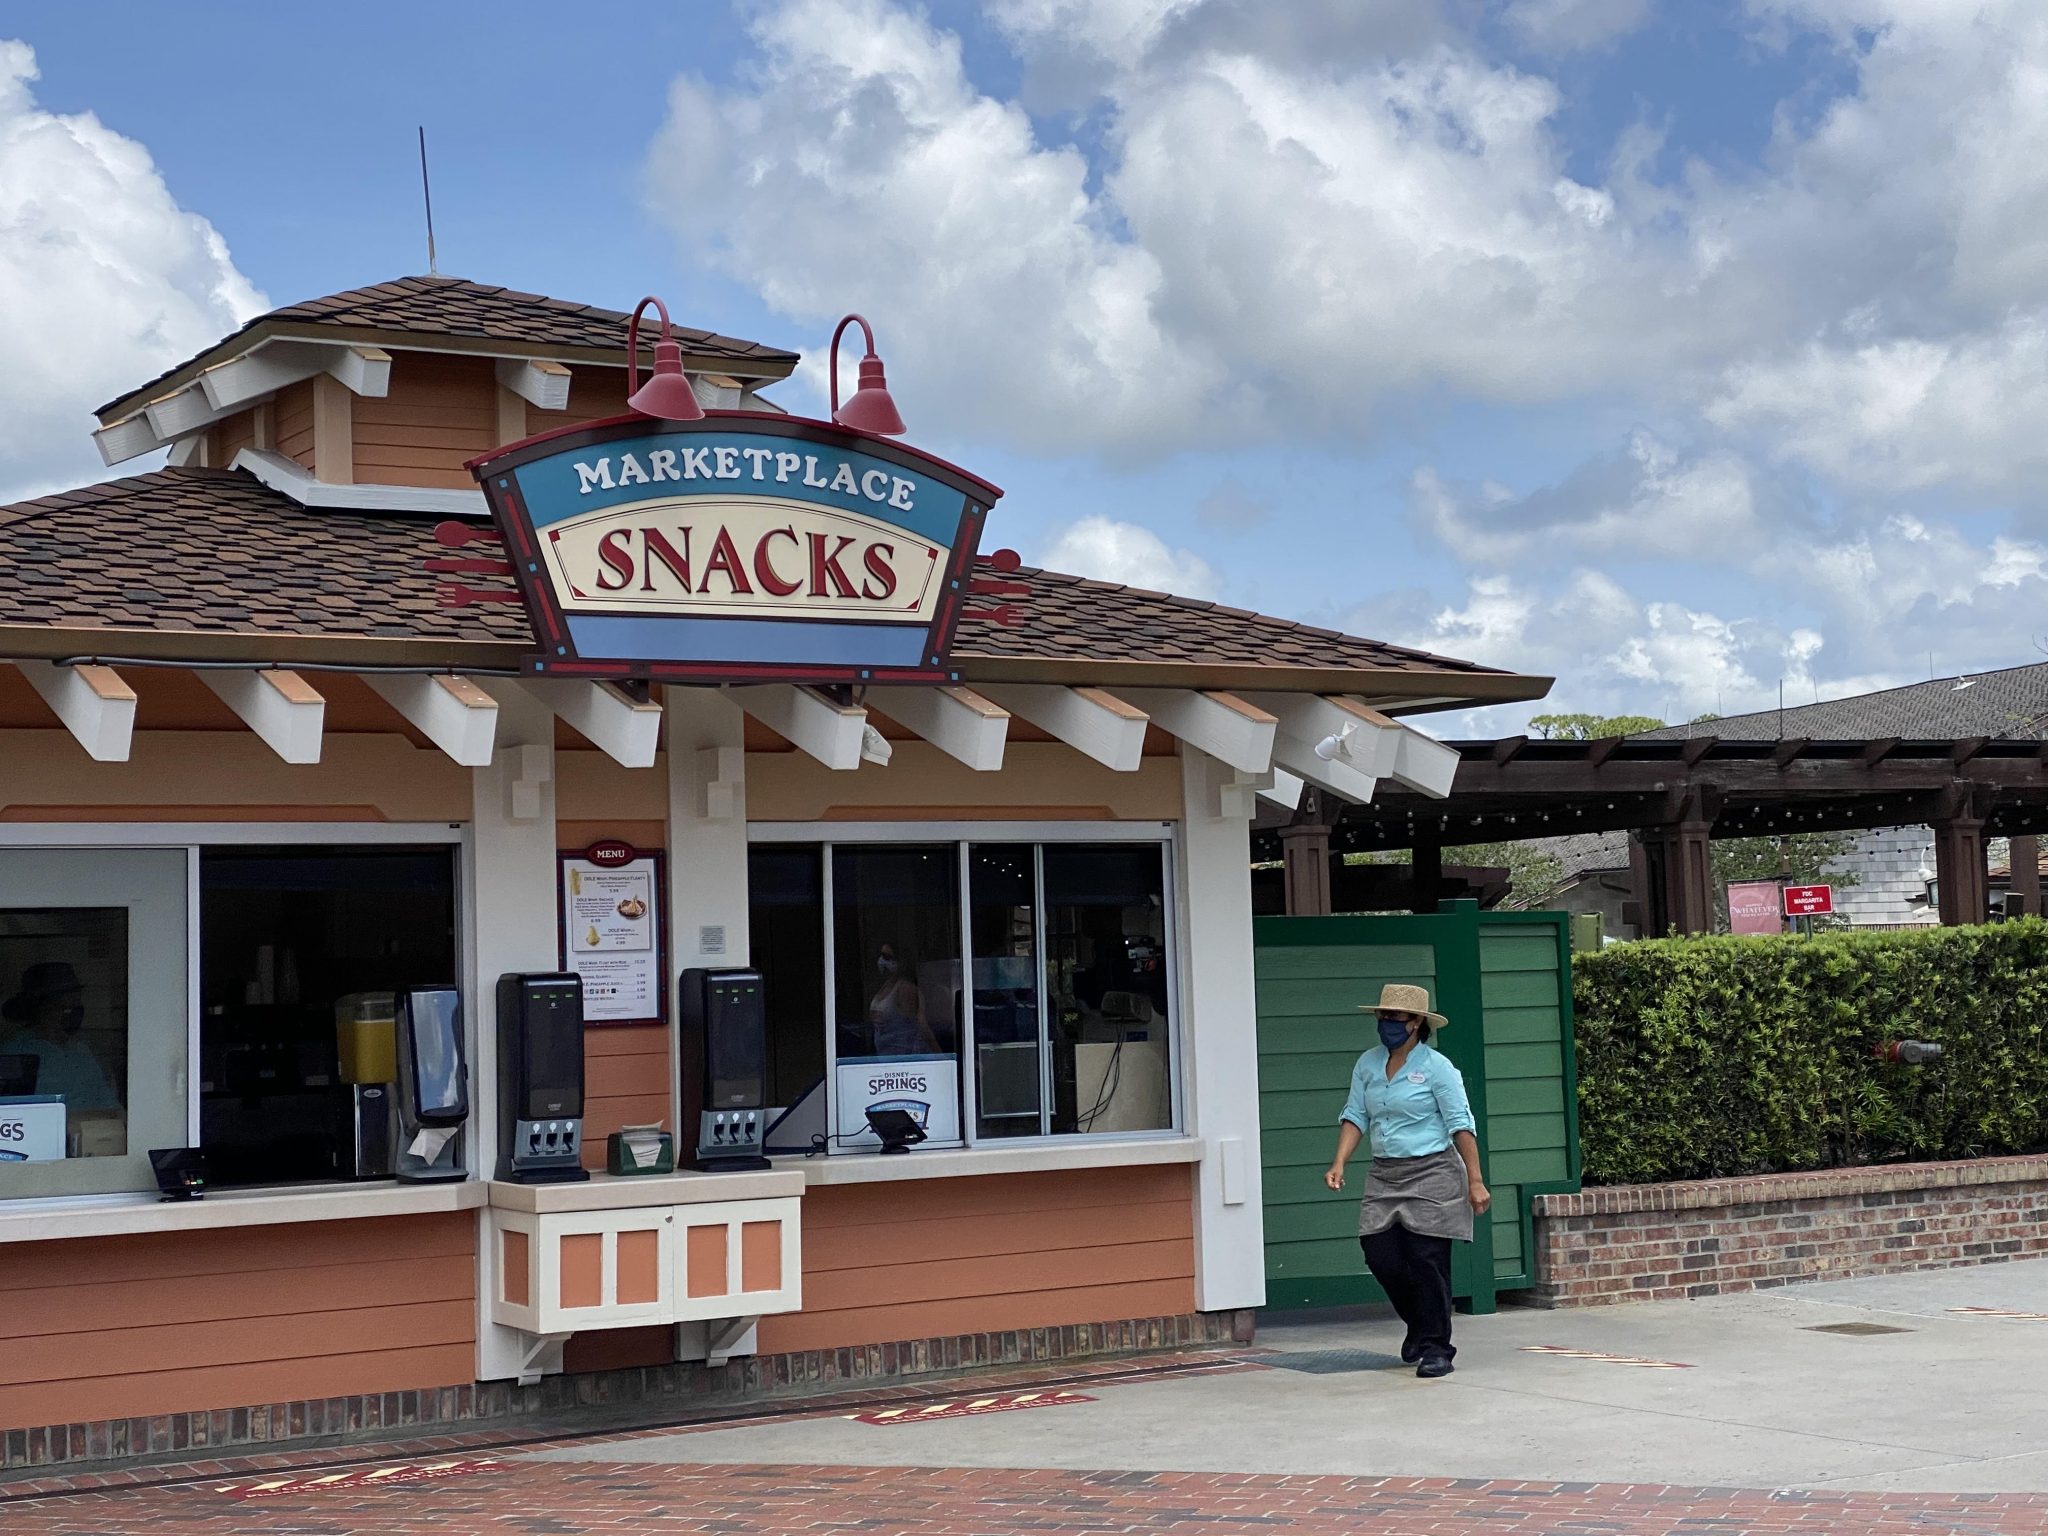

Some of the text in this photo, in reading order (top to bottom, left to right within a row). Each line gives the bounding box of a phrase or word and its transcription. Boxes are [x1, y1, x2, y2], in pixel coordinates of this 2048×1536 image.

[573, 446, 916, 511] MARKETPLACE
[595, 524, 896, 600] SNACKS
[597, 850, 625, 858] MENU
[1794, 897, 1823, 905] MARGARITA
[868, 1077, 927, 1095] SPRINGS
